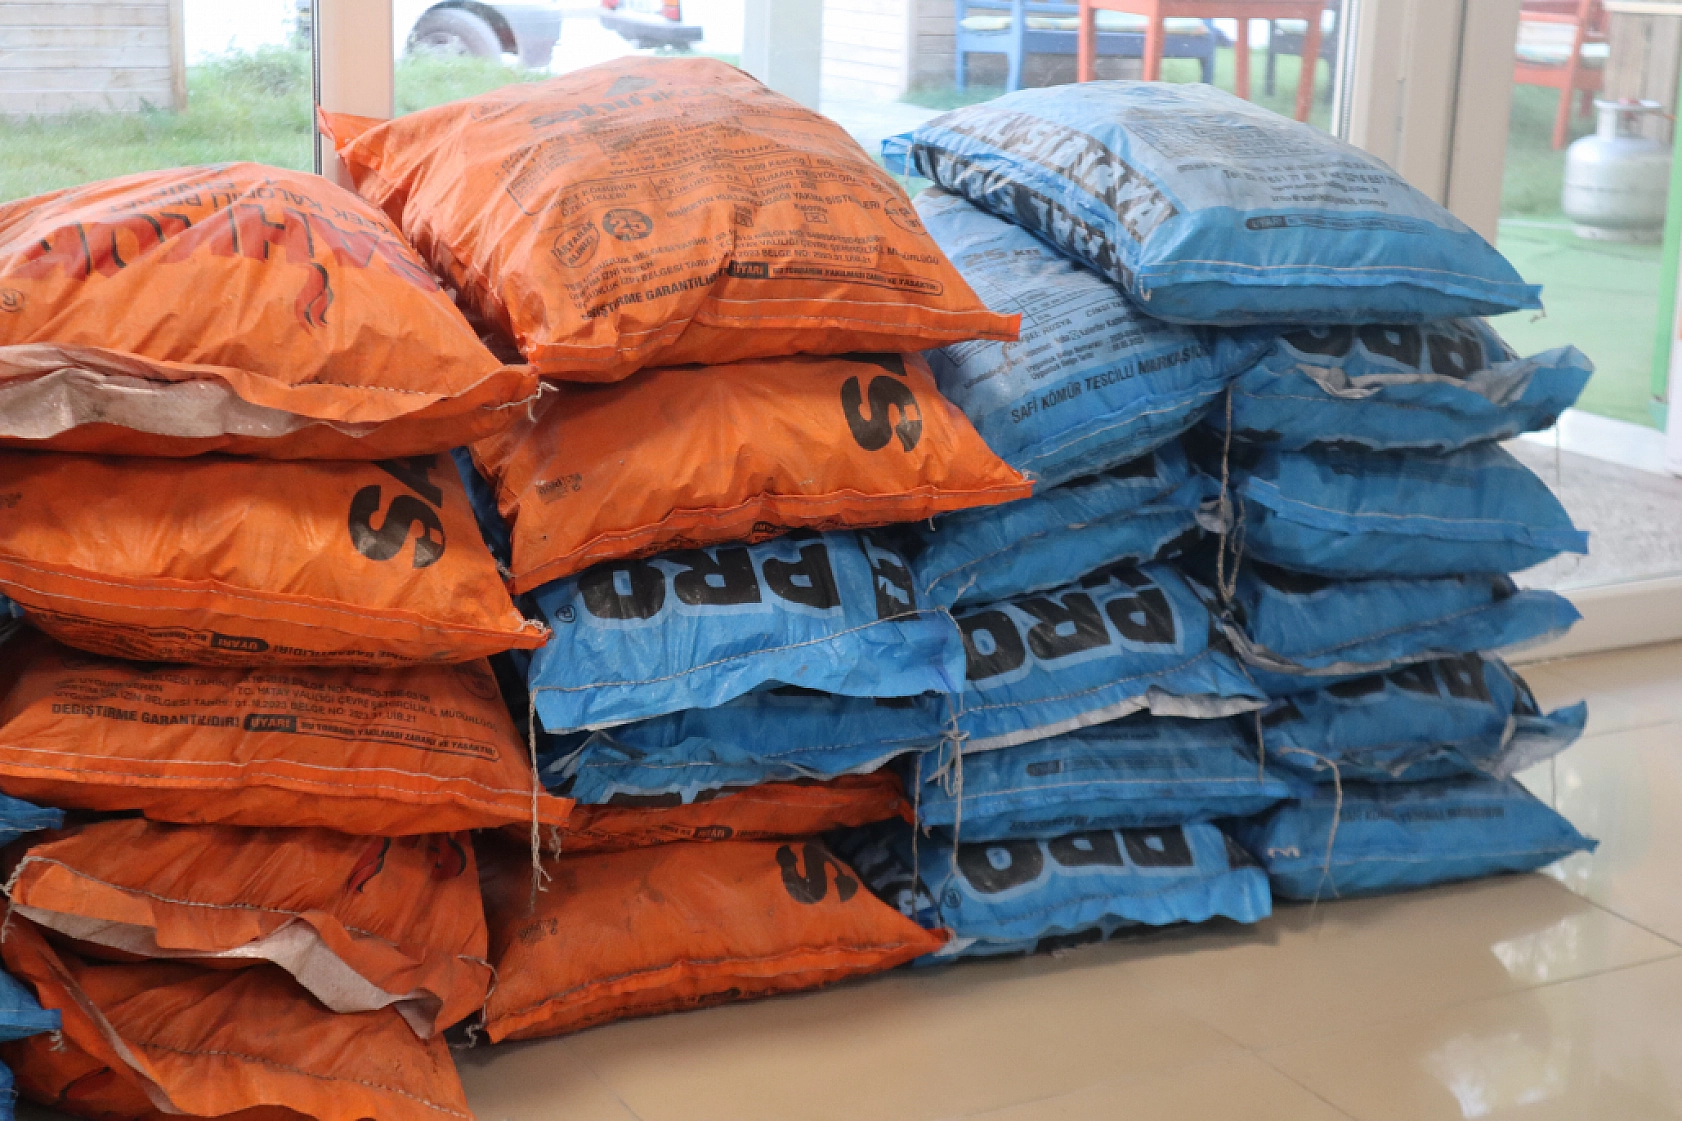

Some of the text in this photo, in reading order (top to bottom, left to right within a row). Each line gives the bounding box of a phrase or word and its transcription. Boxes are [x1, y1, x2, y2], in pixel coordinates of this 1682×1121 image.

[1011, 400, 1039, 424] SAFİ
[1041, 382, 1083, 410] KÖMÜR
[1083, 361, 1135, 392] TESCİLLİ
[577, 543, 841, 620] PRO
[957, 588, 1178, 682] PRO
[250, 718, 292, 729] UYARI
